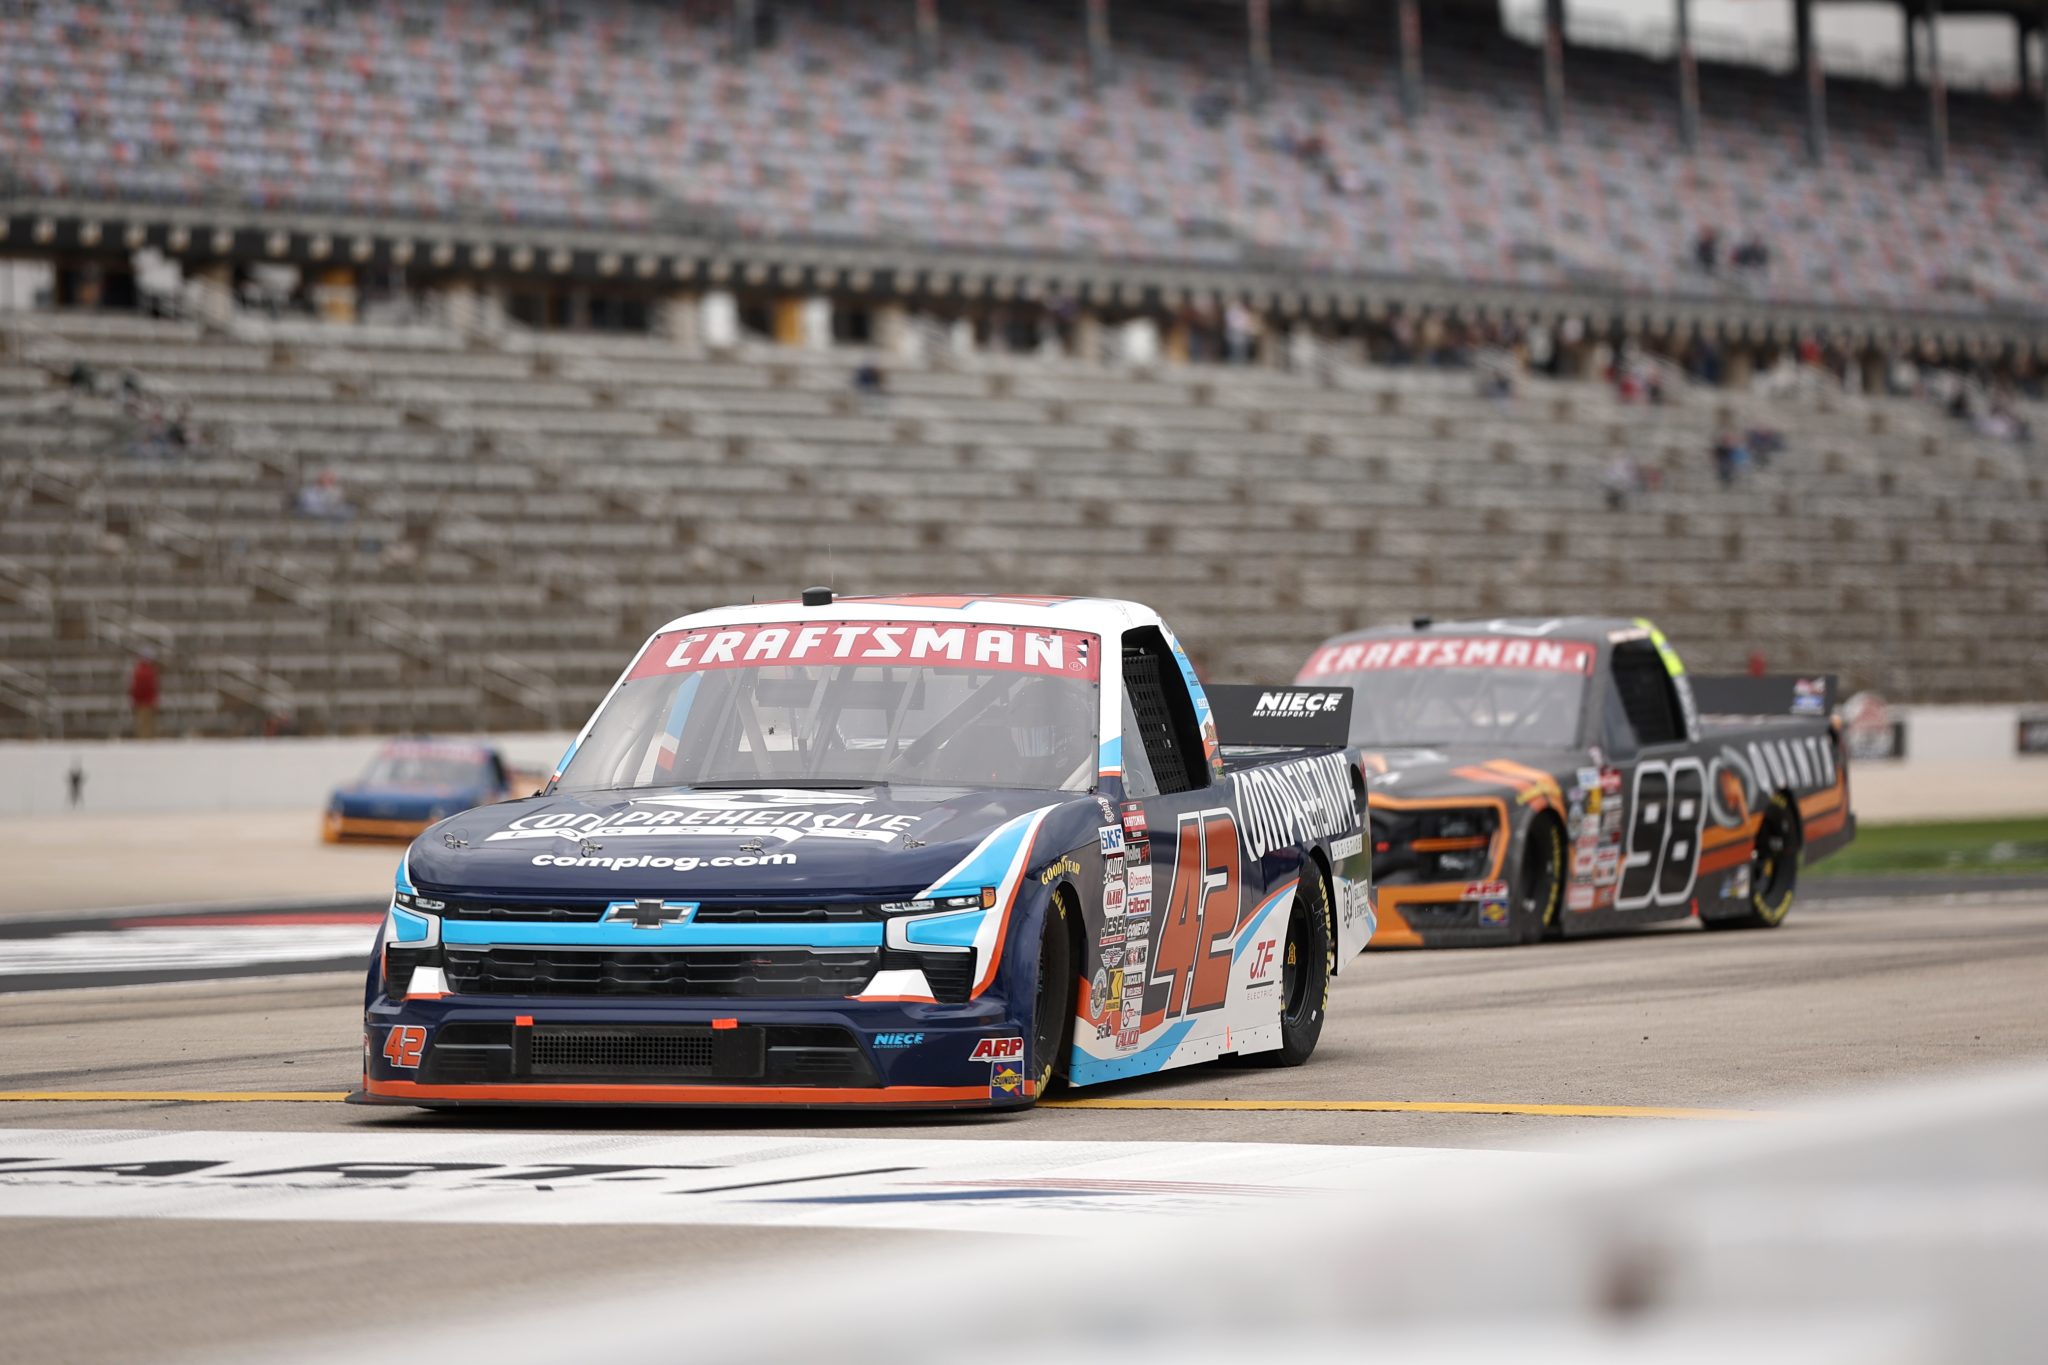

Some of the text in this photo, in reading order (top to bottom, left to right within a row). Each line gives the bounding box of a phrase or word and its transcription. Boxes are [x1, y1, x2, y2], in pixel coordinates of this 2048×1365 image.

[665, 627, 1064, 670] CRAFTSMAN
[1315, 639, 1564, 675] CRAFTSMAN
[1255, 692, 1343, 711] NIECE
[1252, 710, 1315, 718] MOTORSPORTS
[1101, 829, 1122, 849] SKF
[1614, 757, 1708, 911] 98
[531, 852, 797, 871] complog.com
[1041, 856, 1081, 885] GOODYEAR
[1135, 873, 1151, 887] brembo
[1128, 897, 1150, 913] tilton
[1150, 806, 1242, 1020] 42
[1247, 988, 1273, 1000] ELECTRIC
[383, 1025, 427, 1069] 42
[874, 1033, 925, 1045] NIECE
[973, 1039, 1022, 1057] ARP
[992, 1075, 1023, 1086] SUNOCO
